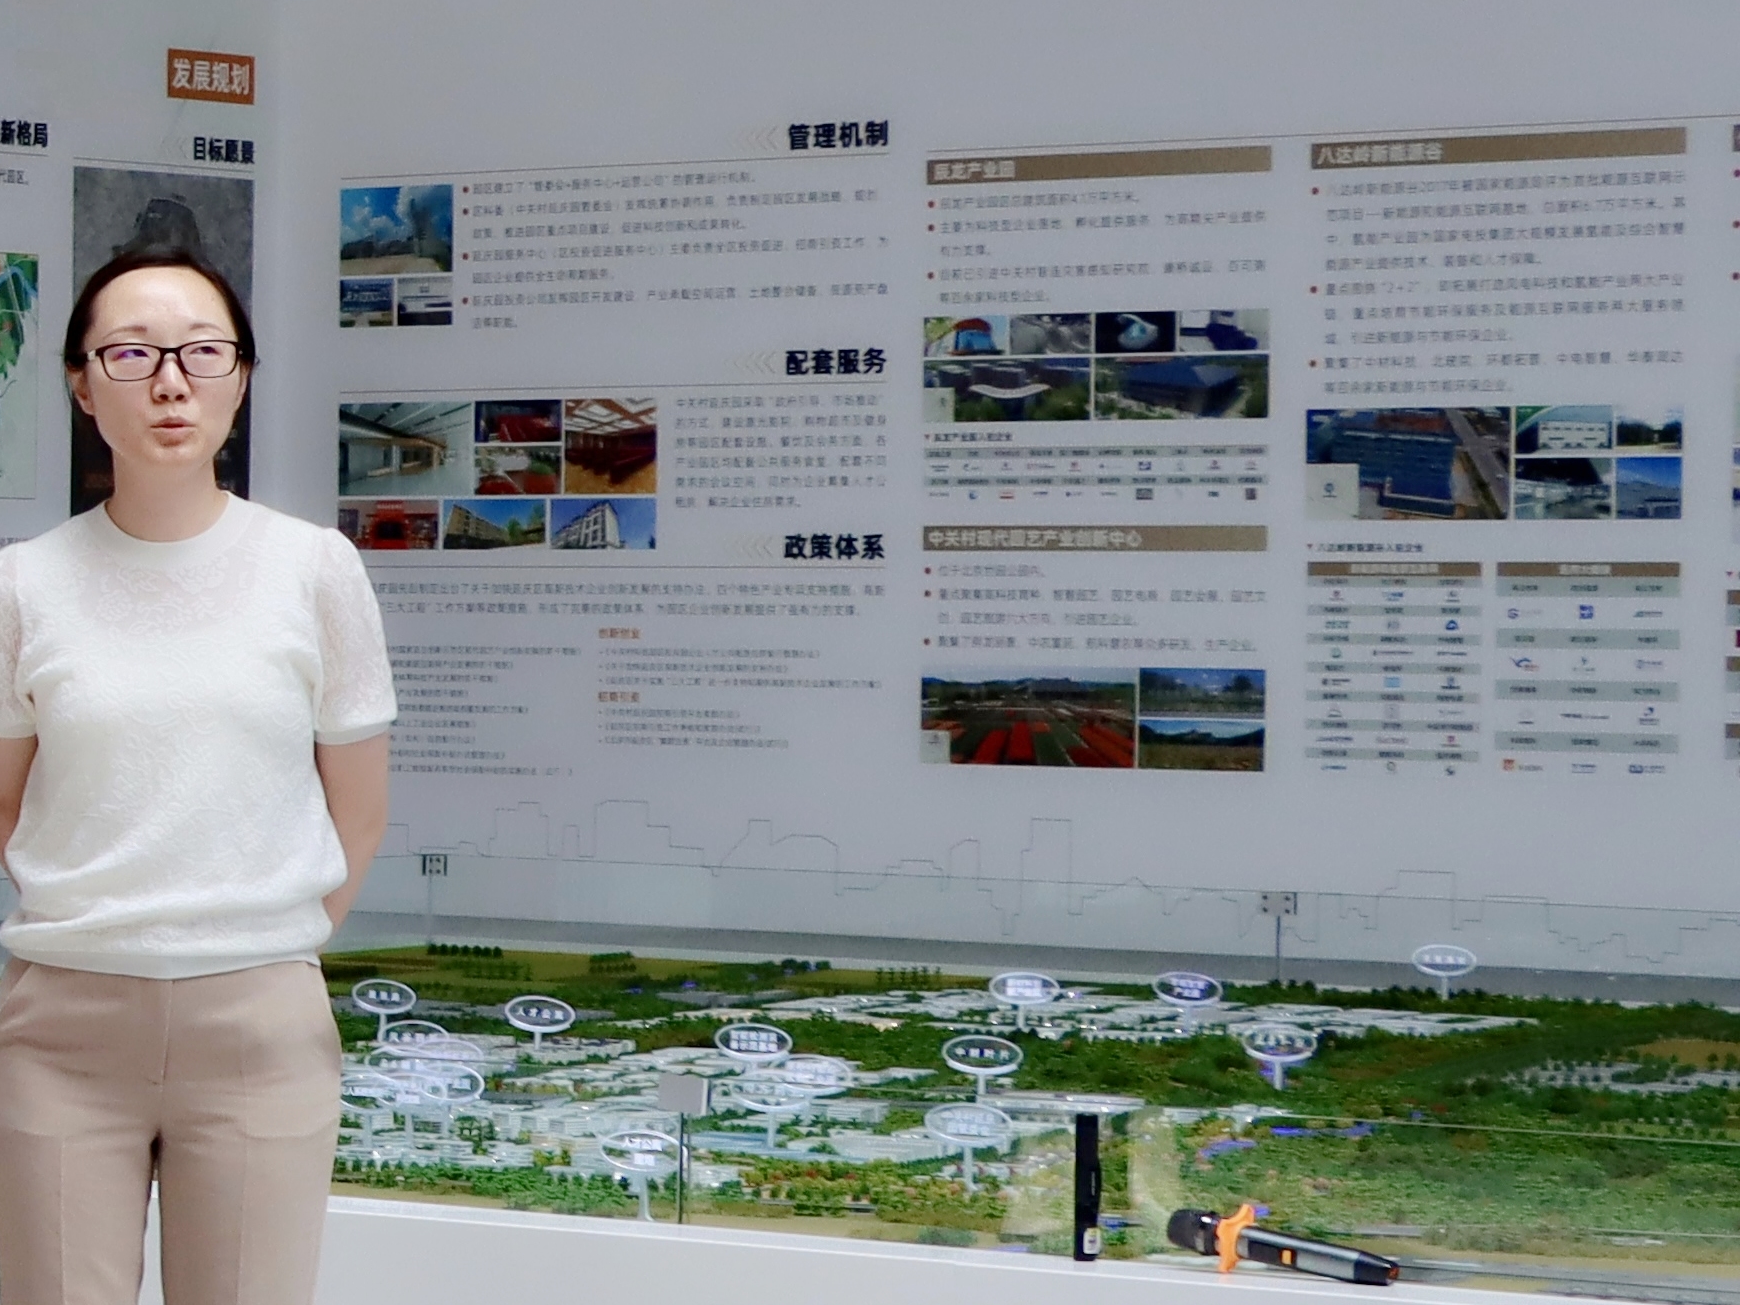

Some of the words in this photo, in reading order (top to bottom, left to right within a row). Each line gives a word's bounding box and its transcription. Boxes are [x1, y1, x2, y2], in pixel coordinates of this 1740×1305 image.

[172, 58, 251, 95] 发展规划
[788, 119, 889, 150] 管理机制
[192, 136, 255, 164] 目标愿景
[785, 347, 887, 377] 配套服务
[784, 533, 884, 560] 政策体系
